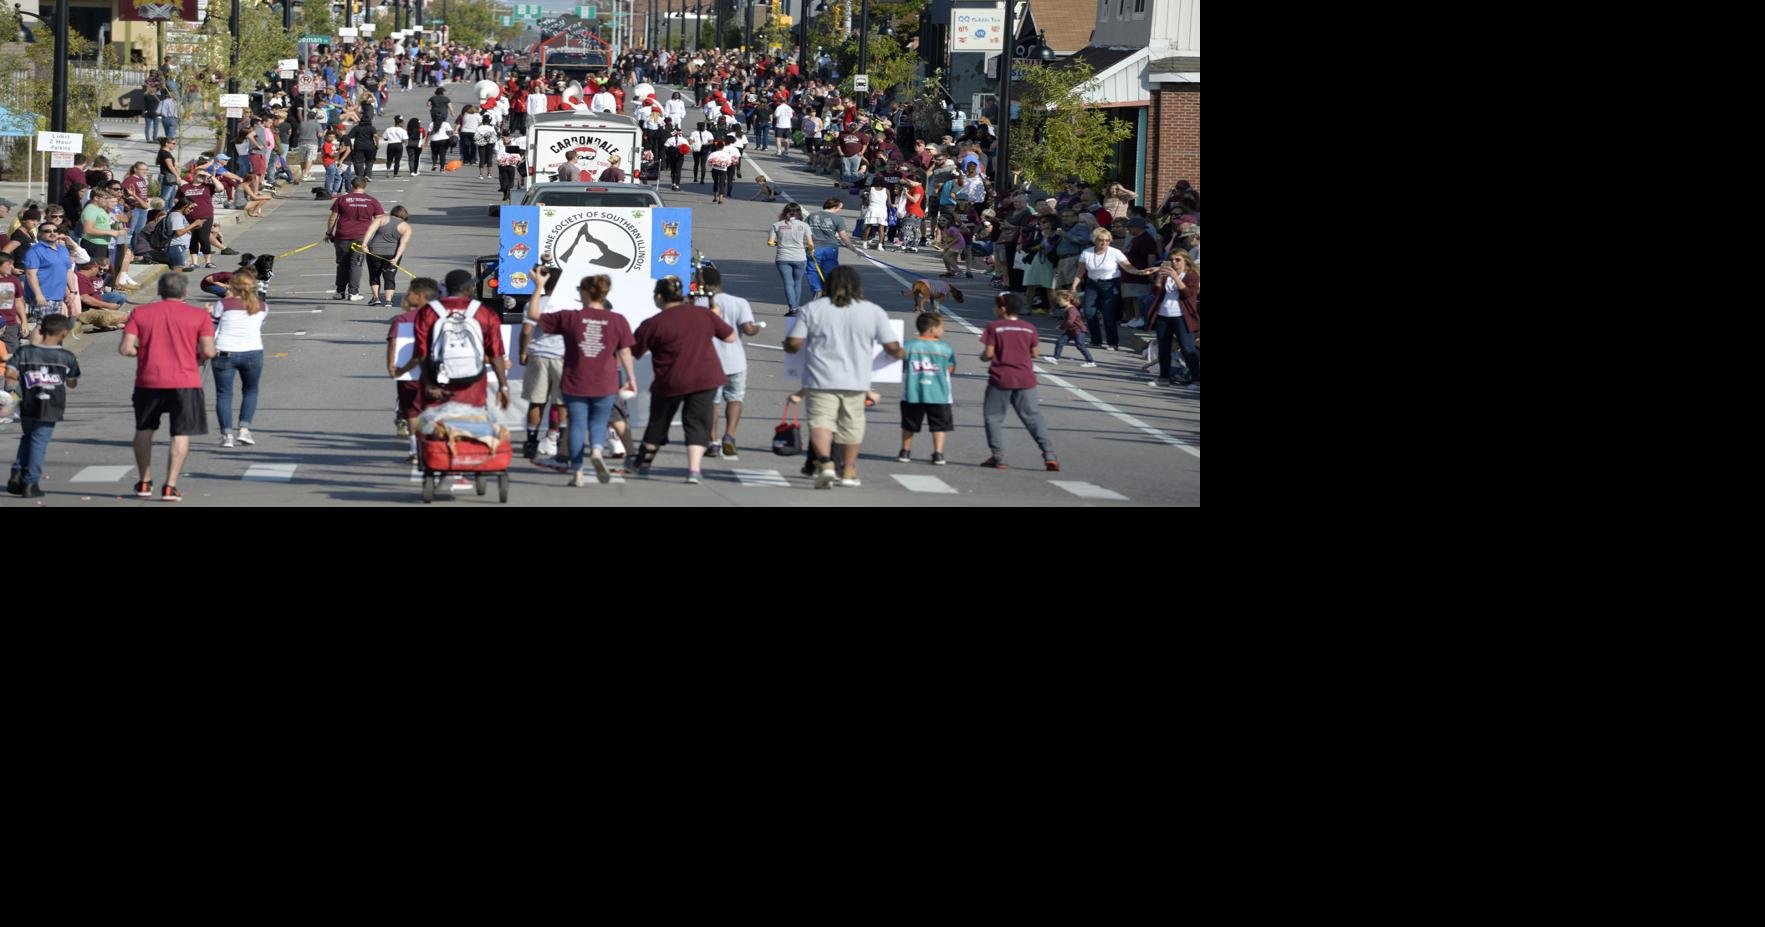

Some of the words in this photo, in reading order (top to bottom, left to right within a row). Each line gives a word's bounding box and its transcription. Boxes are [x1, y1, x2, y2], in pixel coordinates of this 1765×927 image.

[552, 212, 585, 236] SOCIETY
[586, 211, 600, 219] OF
[602, 211, 641, 240] SOUTHERN
[633, 238, 646, 271] ILLINOIS
